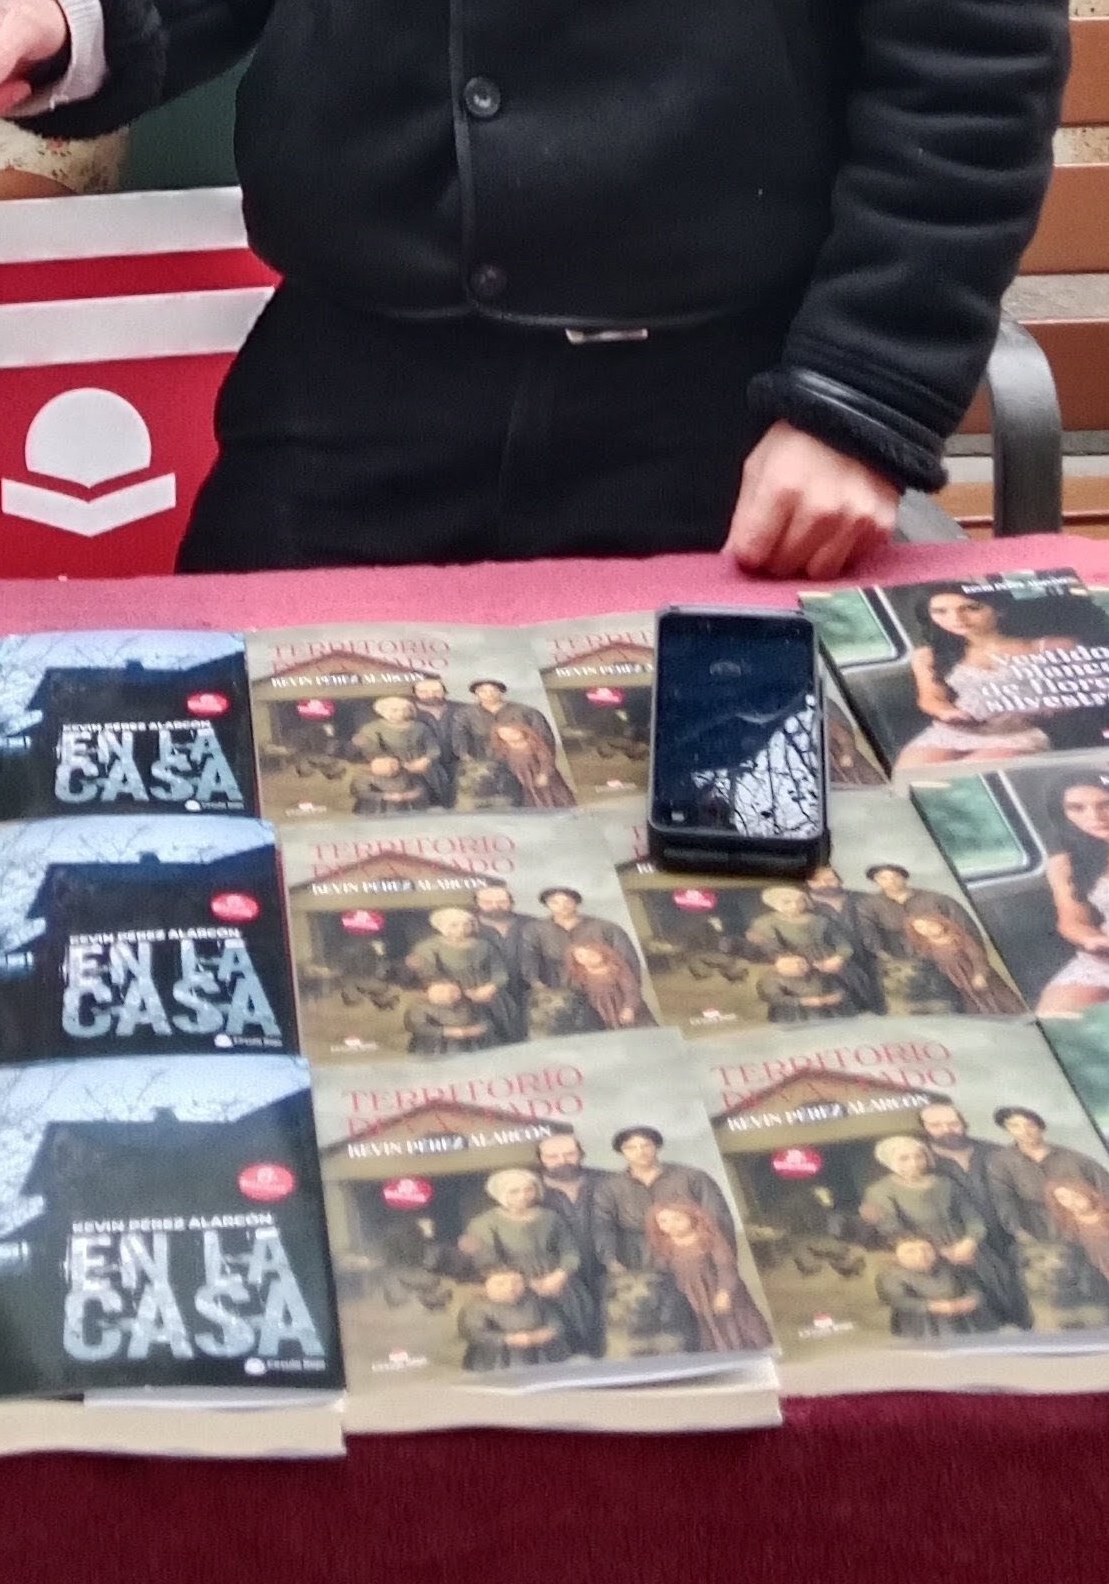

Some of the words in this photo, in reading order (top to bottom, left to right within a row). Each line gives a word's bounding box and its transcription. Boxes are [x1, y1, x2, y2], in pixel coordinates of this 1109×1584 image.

[55, 730, 135, 768] EN
[158, 727, 220, 770] LA
[54, 759, 244, 804] CASA
[312, 835, 516, 860] TERRITORIO
[60, 941, 156, 990] EN
[180, 938, 252, 992] LA
[62, 978, 283, 1038] CASA
[712, 1041, 952, 1086] TERRITORIO
[341, 1065, 584, 1113] TERRITORIO
[727, 1111, 782, 1132] KEVIN
[347, 1142, 403, 1159] KEVIN
[71, 1220, 126, 1234] KEVIN
[62, 1232, 170, 1292] EN
[202, 1226, 290, 1292] LA
[63, 1277, 326, 1361] CASA
